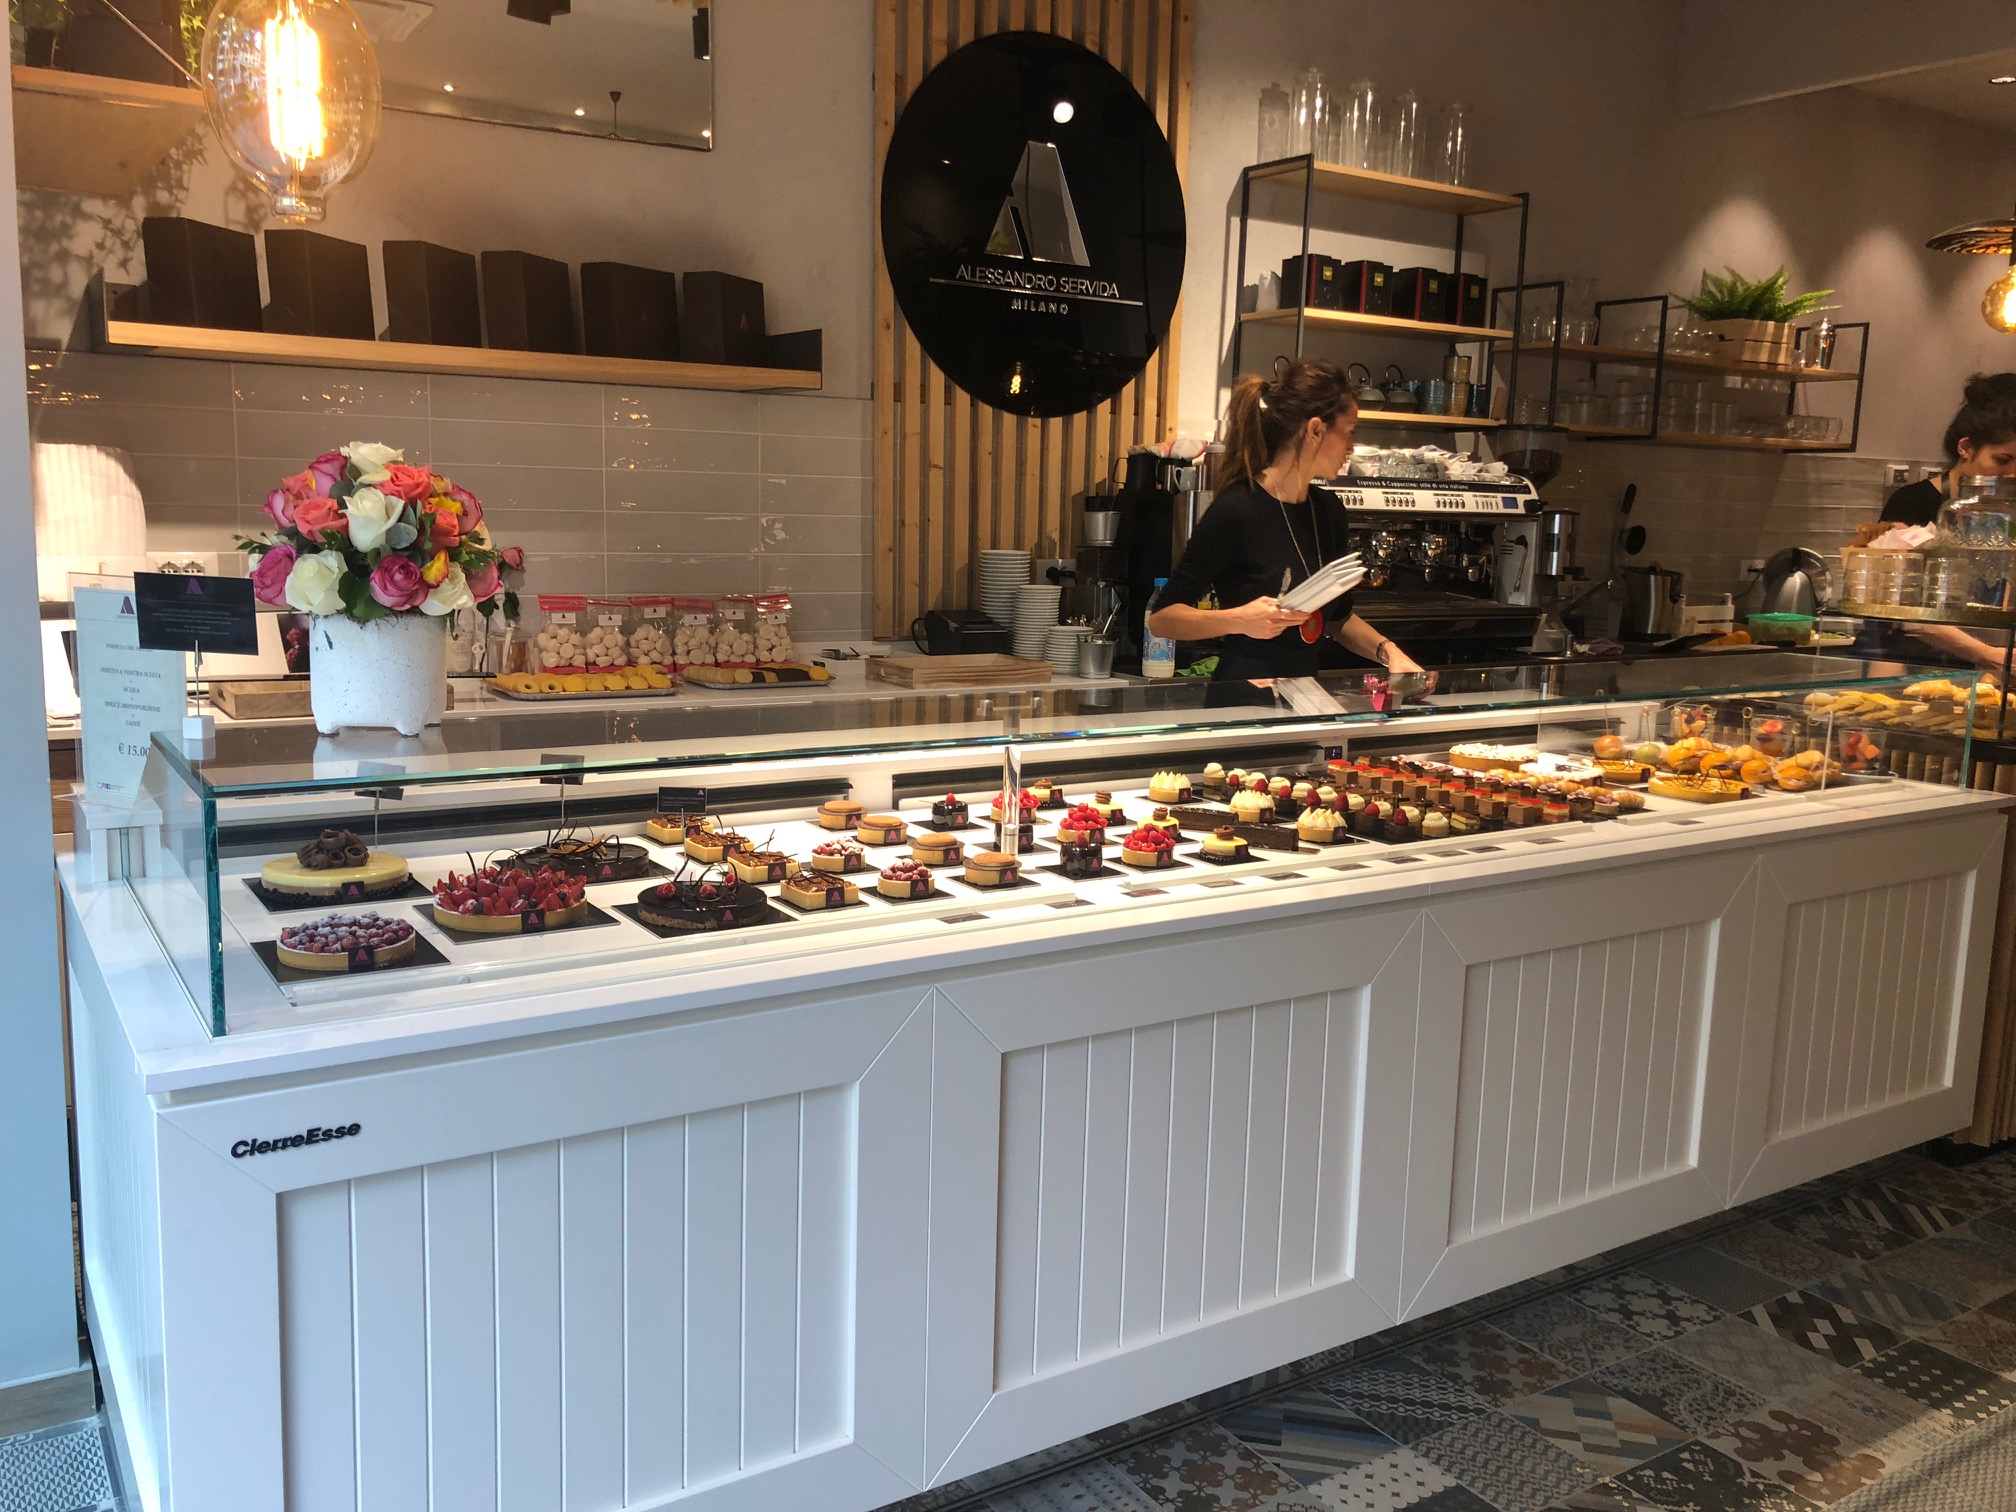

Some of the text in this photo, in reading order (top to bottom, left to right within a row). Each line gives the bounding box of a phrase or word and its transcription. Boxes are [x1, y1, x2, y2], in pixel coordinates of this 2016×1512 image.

[956, 264, 1119, 298] ALESSANDRO SERVIDA
[1011, 298, 1069, 315] MILANO
[1356, 479, 1381, 487] Espresso
[1387, 481, 1418, 489] Cappuccino:
[123, 686, 140, 694] ACQUA
[230, 1122, 362, 1159] CierreEsse
